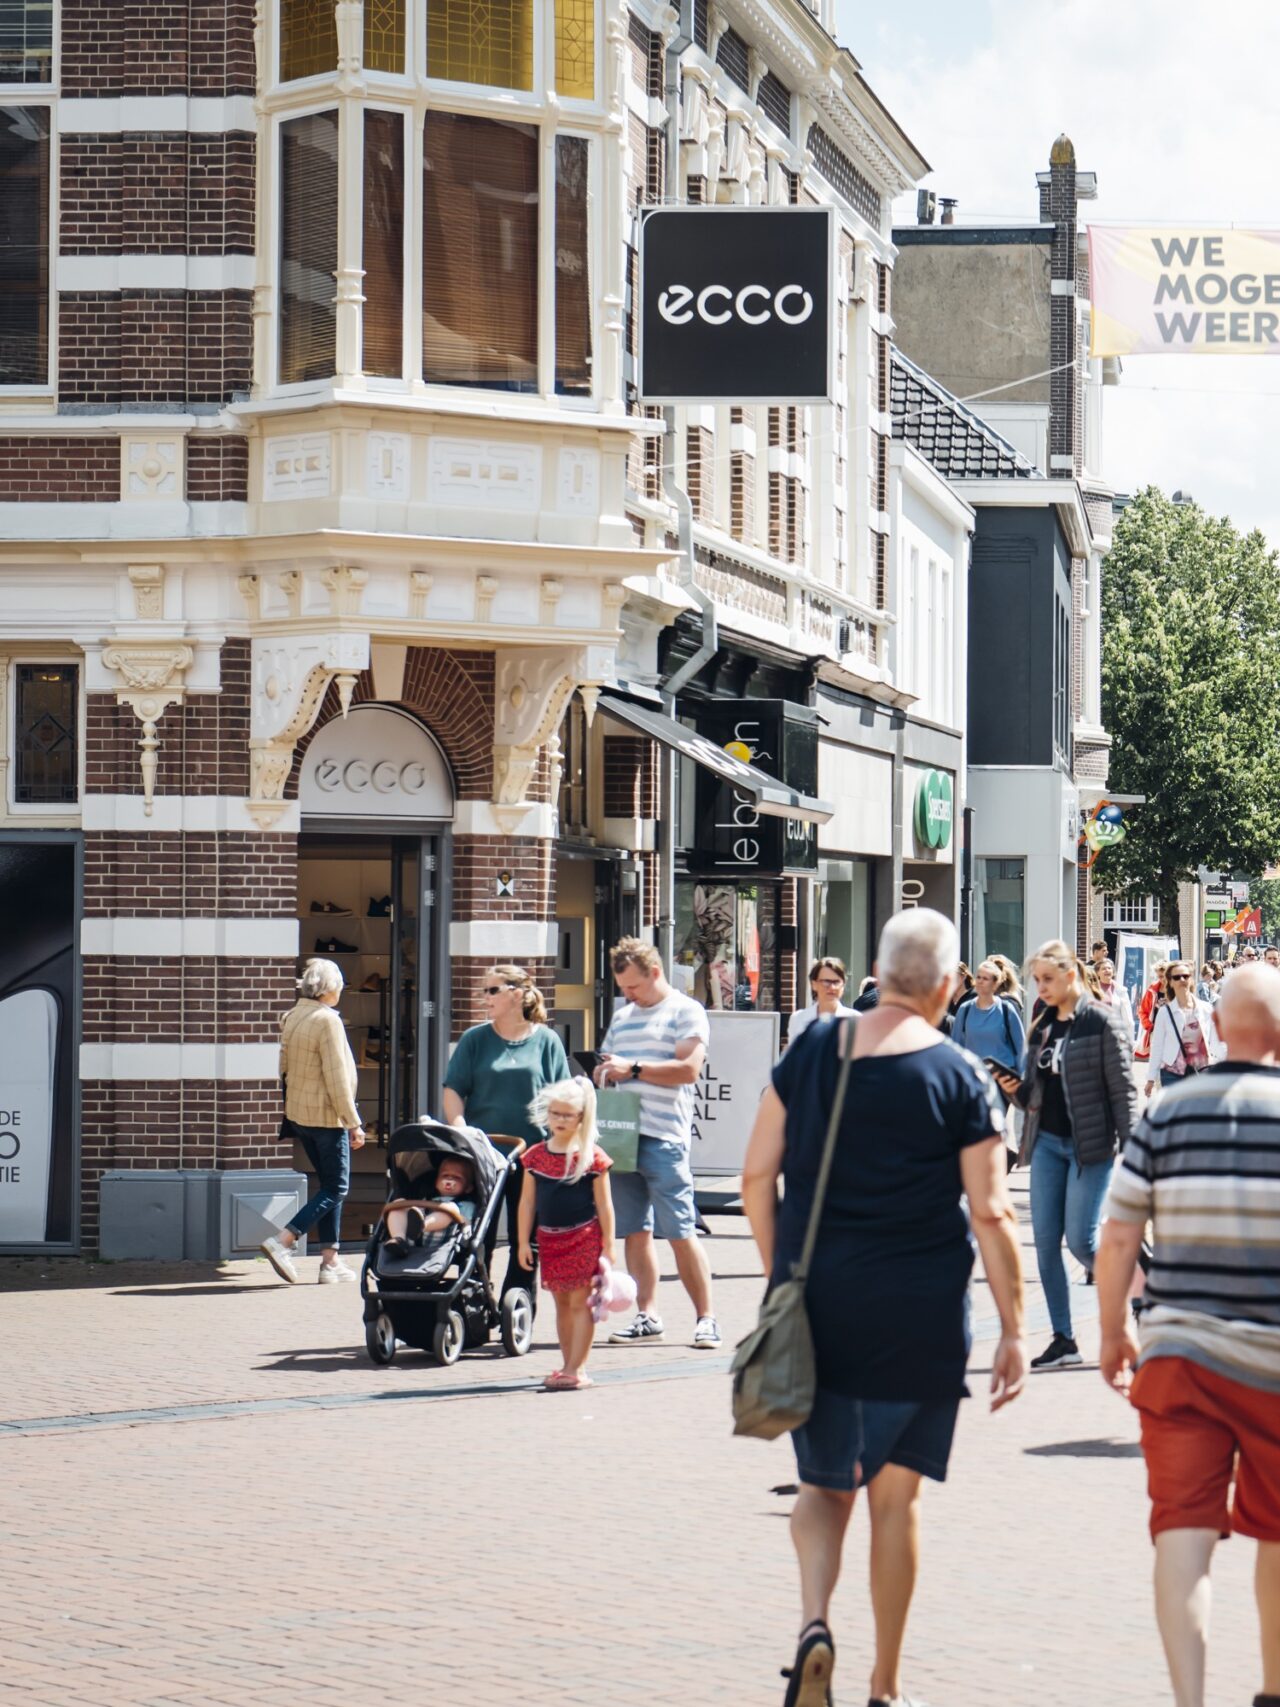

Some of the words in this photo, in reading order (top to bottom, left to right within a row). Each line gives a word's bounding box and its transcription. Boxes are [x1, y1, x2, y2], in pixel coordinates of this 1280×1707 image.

[1151, 236, 1225, 267] WE
[657, 284, 814, 325] ecco
[1154, 311, 1280, 344] WEER
[314, 758, 426, 796] ecco
[607, 1120, 637, 1130] CENTRE
